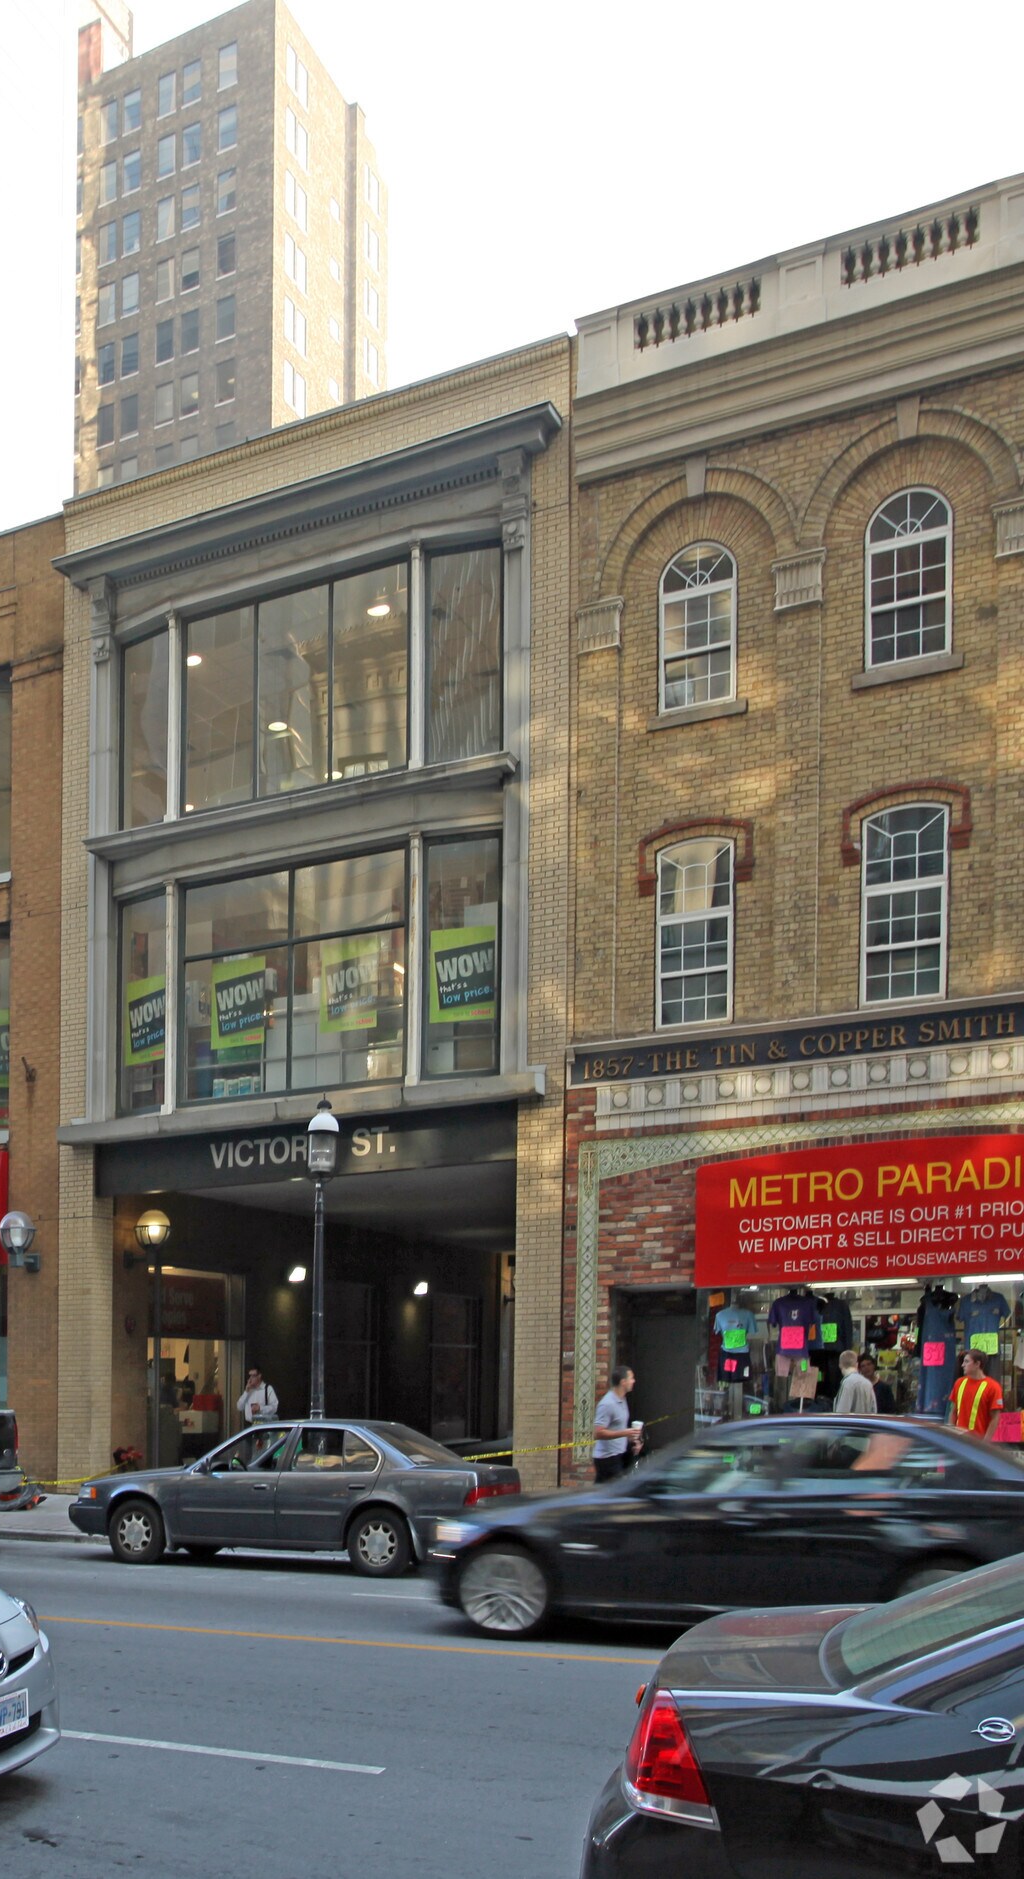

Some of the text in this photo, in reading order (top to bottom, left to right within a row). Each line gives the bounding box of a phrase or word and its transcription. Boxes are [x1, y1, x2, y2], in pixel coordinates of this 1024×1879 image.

[327, 960, 376, 994] WOW
[437, 948, 493, 982] WOW
[217, 977, 264, 1011] WOW
[443, 993, 460, 1004] low
[130, 995, 165, 1028] WOW
[221, 1020, 236, 1031] low
[133, 1037, 145, 1048] low
[710, 1043, 756, 1066] TIN
[767, 1040, 788, 1060] &
[799, 1025, 907, 1056] COPPER
[918, 1012, 1016, 1043] SMITH
[209, 1126, 396, 1169] VICTOR ST.
[729, 1155, 1021, 1209] METRO PARADI
[739, 1200, 1024, 1234] CUSTOMER CARE IS OUR #1 PRIO
[739, 1222, 1024, 1253] WE IMPORT & SELL DIRECT TO PU
[784, 1248, 1024, 1273] ELECTRONICS HOUSEWARES TOY
